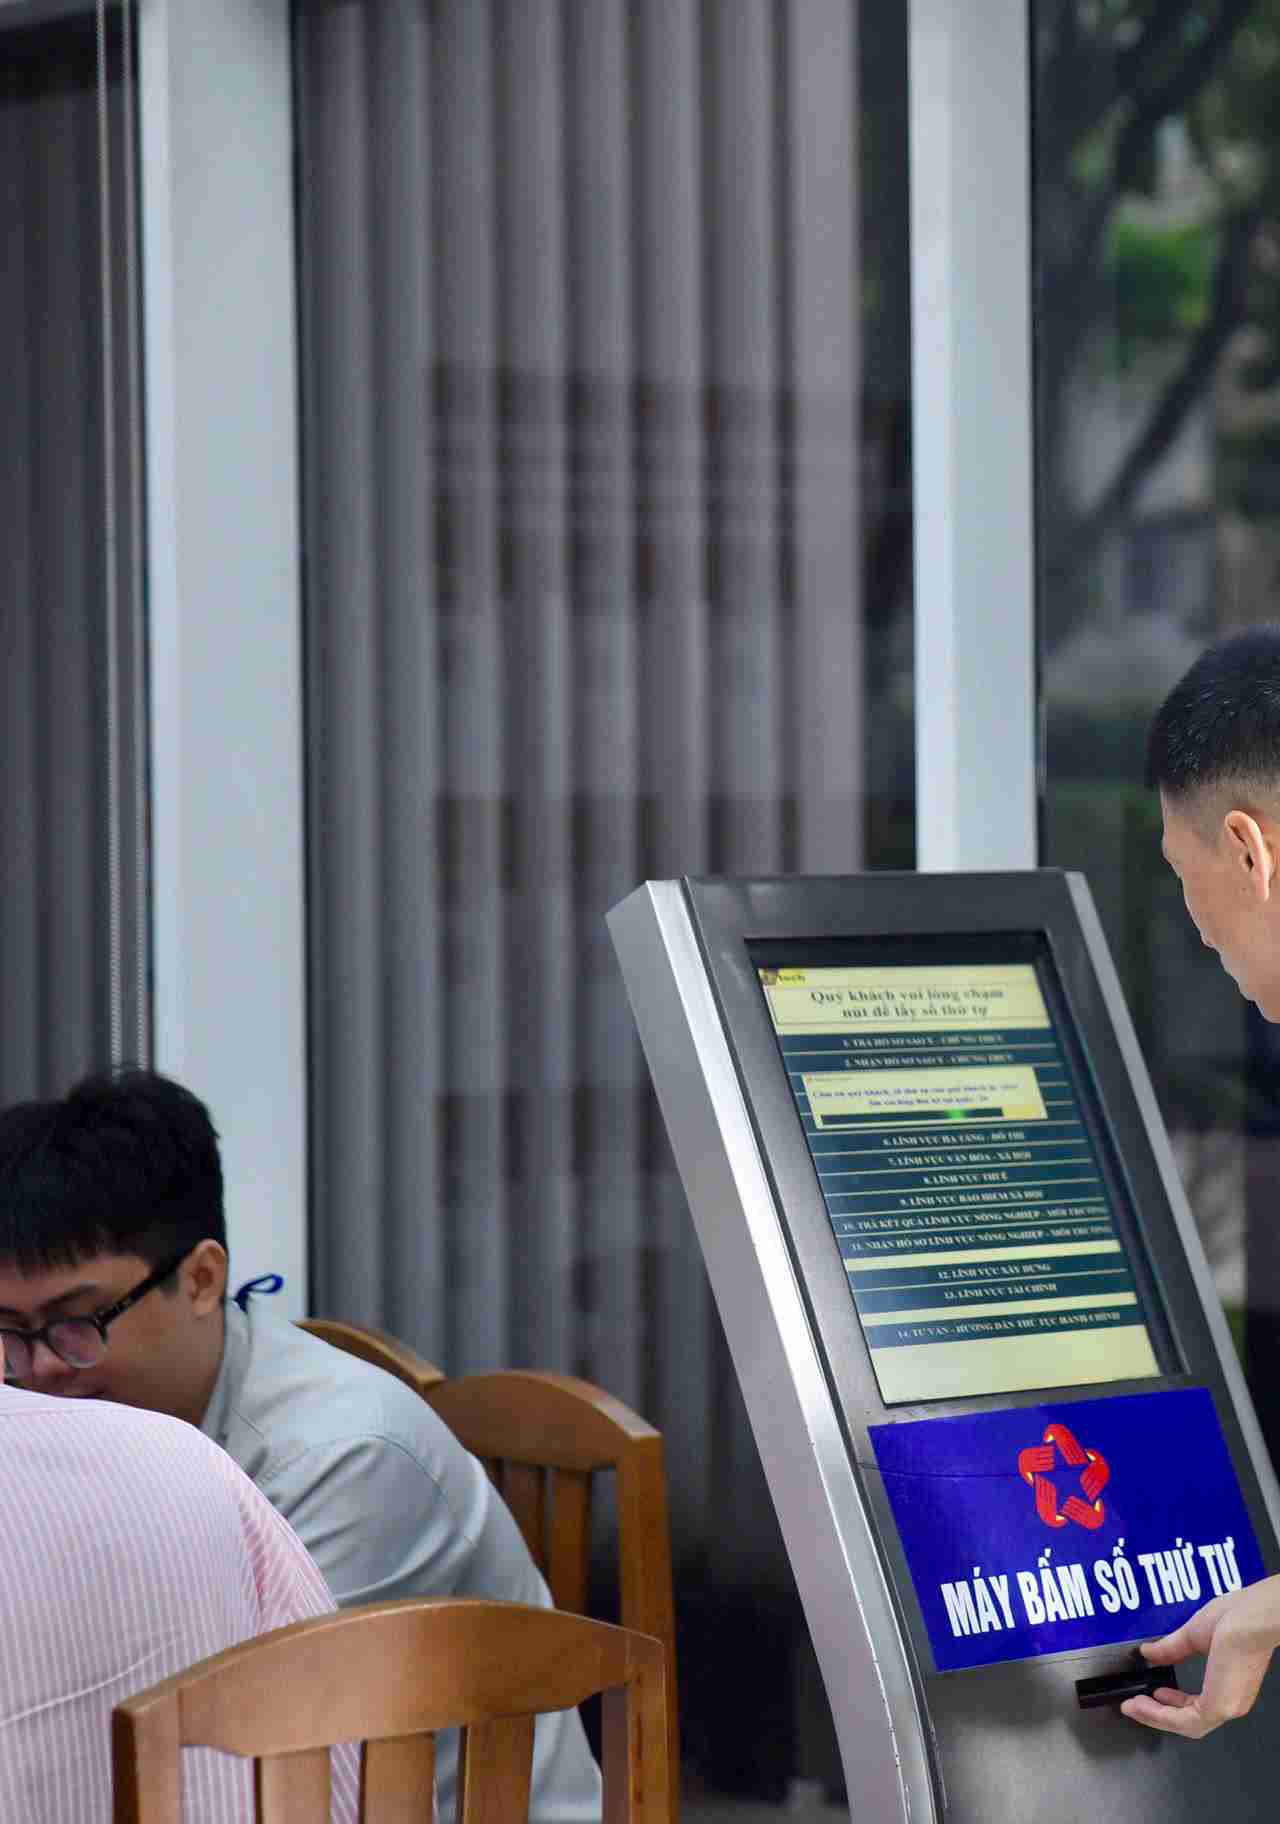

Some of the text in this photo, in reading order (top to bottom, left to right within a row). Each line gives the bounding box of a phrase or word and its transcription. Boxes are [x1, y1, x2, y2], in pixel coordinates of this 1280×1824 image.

[810, 988, 843, 1005] Quý
[848, 989, 896, 1001] khách
[940, 1567, 1016, 1637] MÁY
[1017, 1548, 1096, 1626] BẤM
[1094, 1538, 1140, 1614] SỐ
[1139, 1538, 1202, 1607] THỨ
